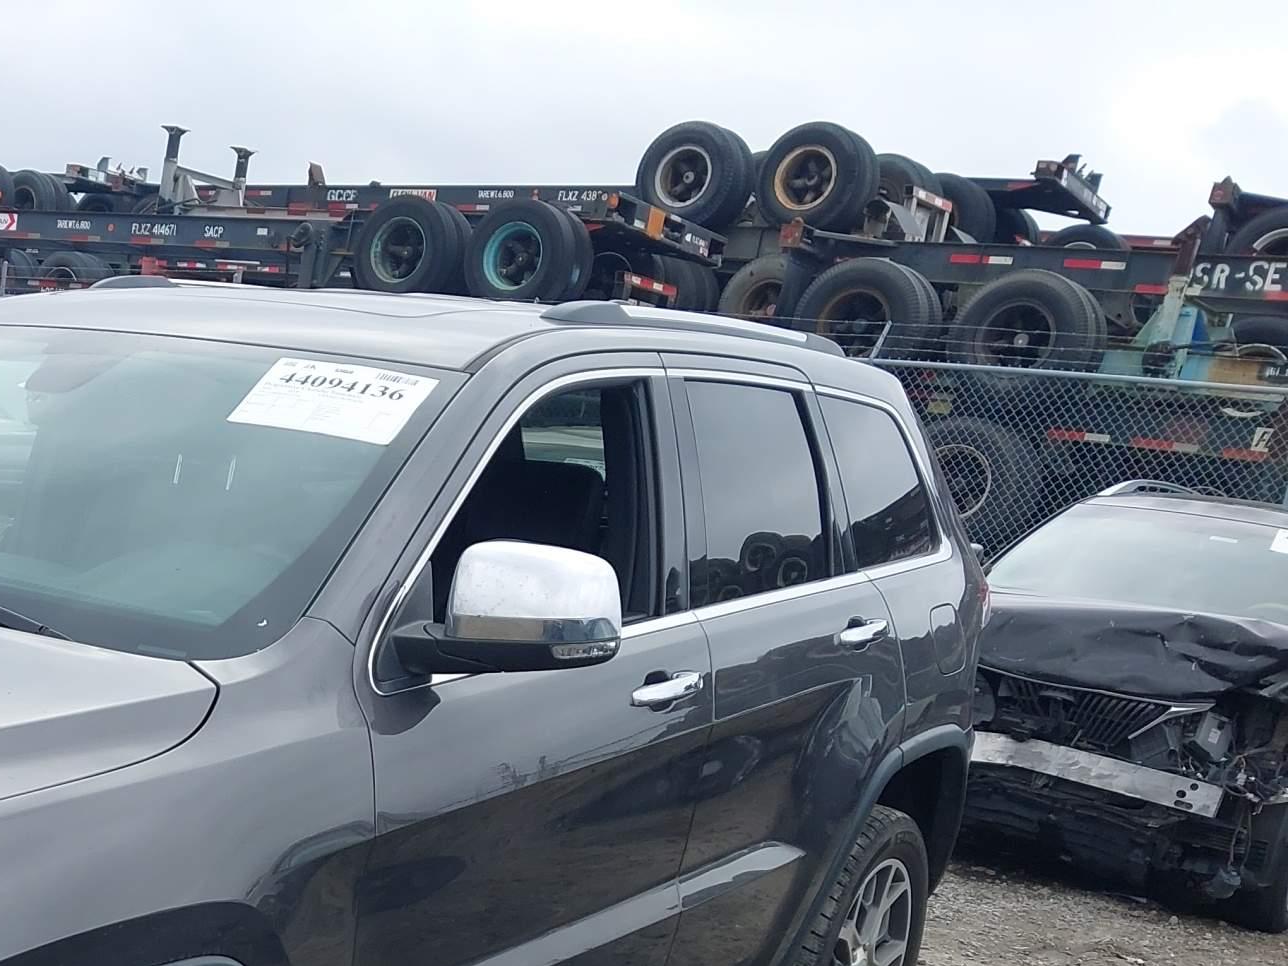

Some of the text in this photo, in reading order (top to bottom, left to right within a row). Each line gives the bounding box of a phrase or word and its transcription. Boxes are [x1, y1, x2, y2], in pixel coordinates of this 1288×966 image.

[558, 190, 578, 201] FLXZ
[131, 223, 150, 235] FLXZ
[204, 225, 224, 238] SACP
[279, 372, 406, 401] 44094136
